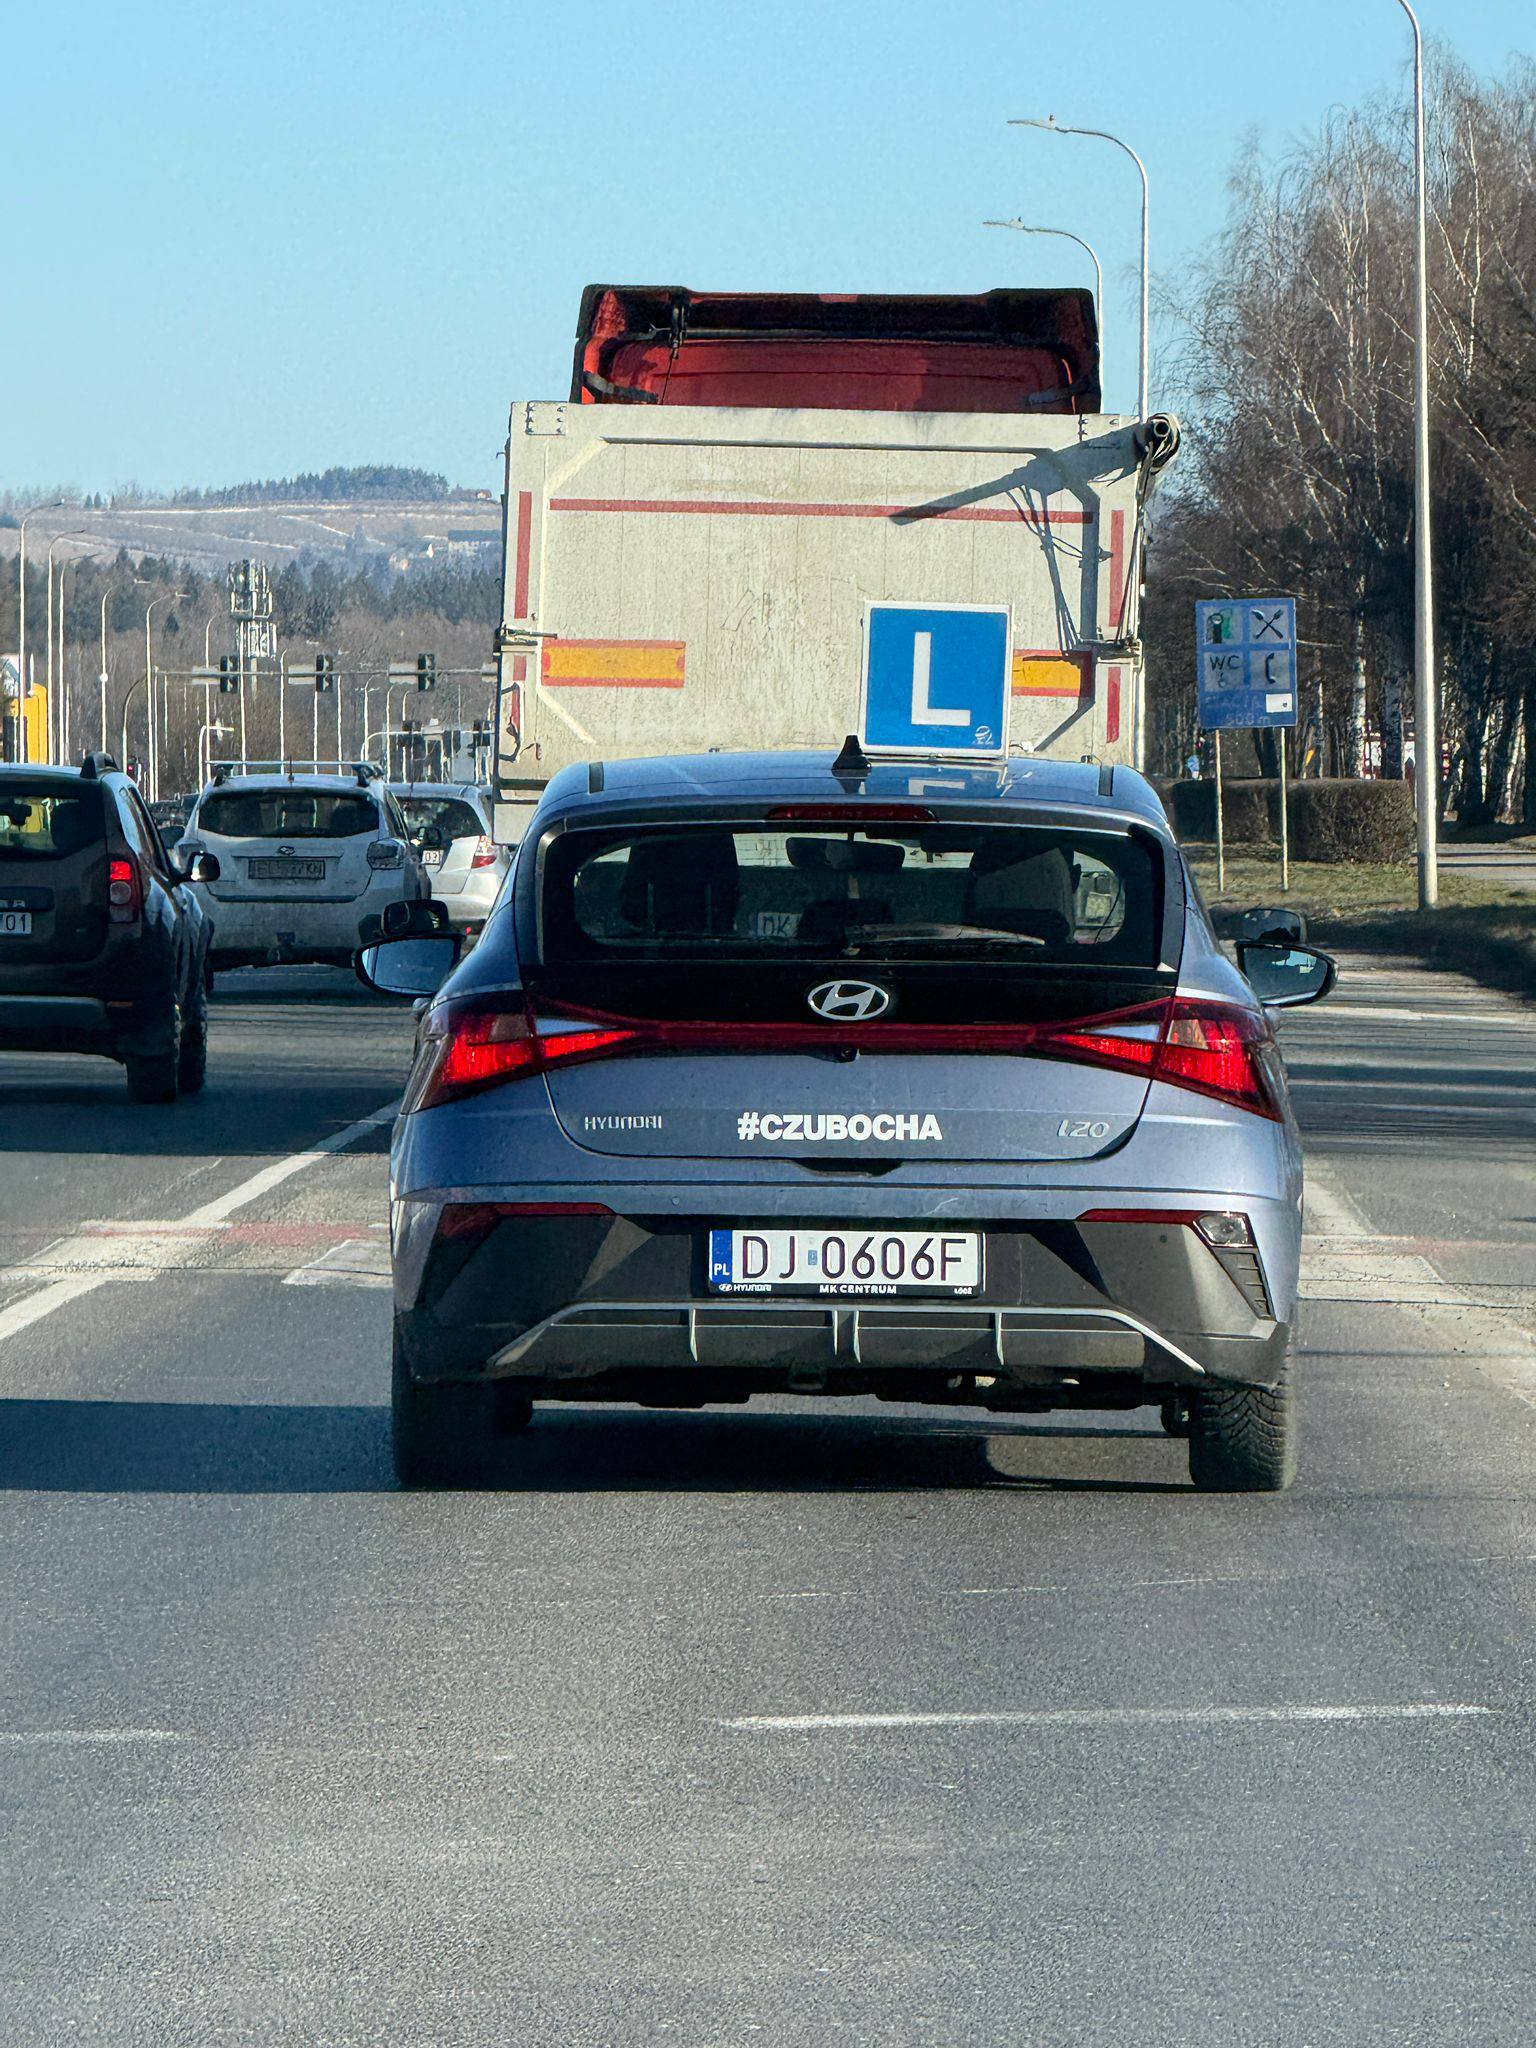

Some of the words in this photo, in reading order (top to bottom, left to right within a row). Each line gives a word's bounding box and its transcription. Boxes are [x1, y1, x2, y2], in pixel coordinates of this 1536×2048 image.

[1209, 655, 1239, 670] WC
[911, 631, 971, 726] L
[0, 914, 26, 932] 01
[584, 1115, 662, 1130] HYUNDAI
[737, 1112, 943, 1141] #CZUBOCHA
[743, 1236, 795, 1279] DJ
[821, 1236, 966, 1281] 0606F
[714, 1263, 730, 1276] PL
[819, 1284, 838, 1293] MK
[839, 1284, 897, 1294] CENTRUM
